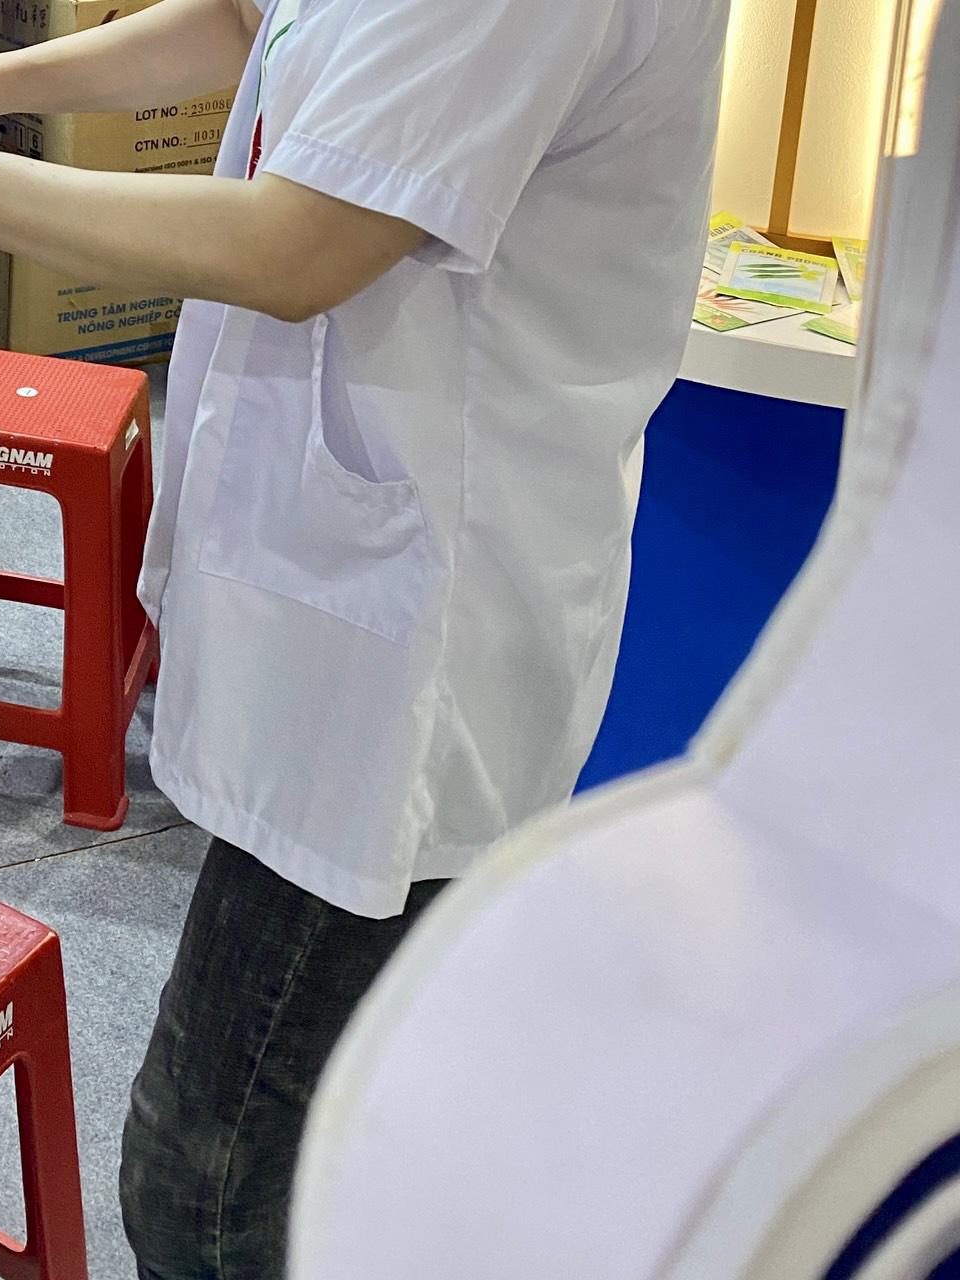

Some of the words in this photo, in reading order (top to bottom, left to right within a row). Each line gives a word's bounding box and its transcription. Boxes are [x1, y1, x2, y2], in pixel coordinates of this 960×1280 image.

[135, 109, 158, 121] LOT
[135, 139, 159, 152] CTN
[57, 308, 98, 323] TRUNG
[101, 302, 127, 316] TÂM
[78, 321, 115, 335] NÔNG
[165, 306, 182, 319] CÔ
